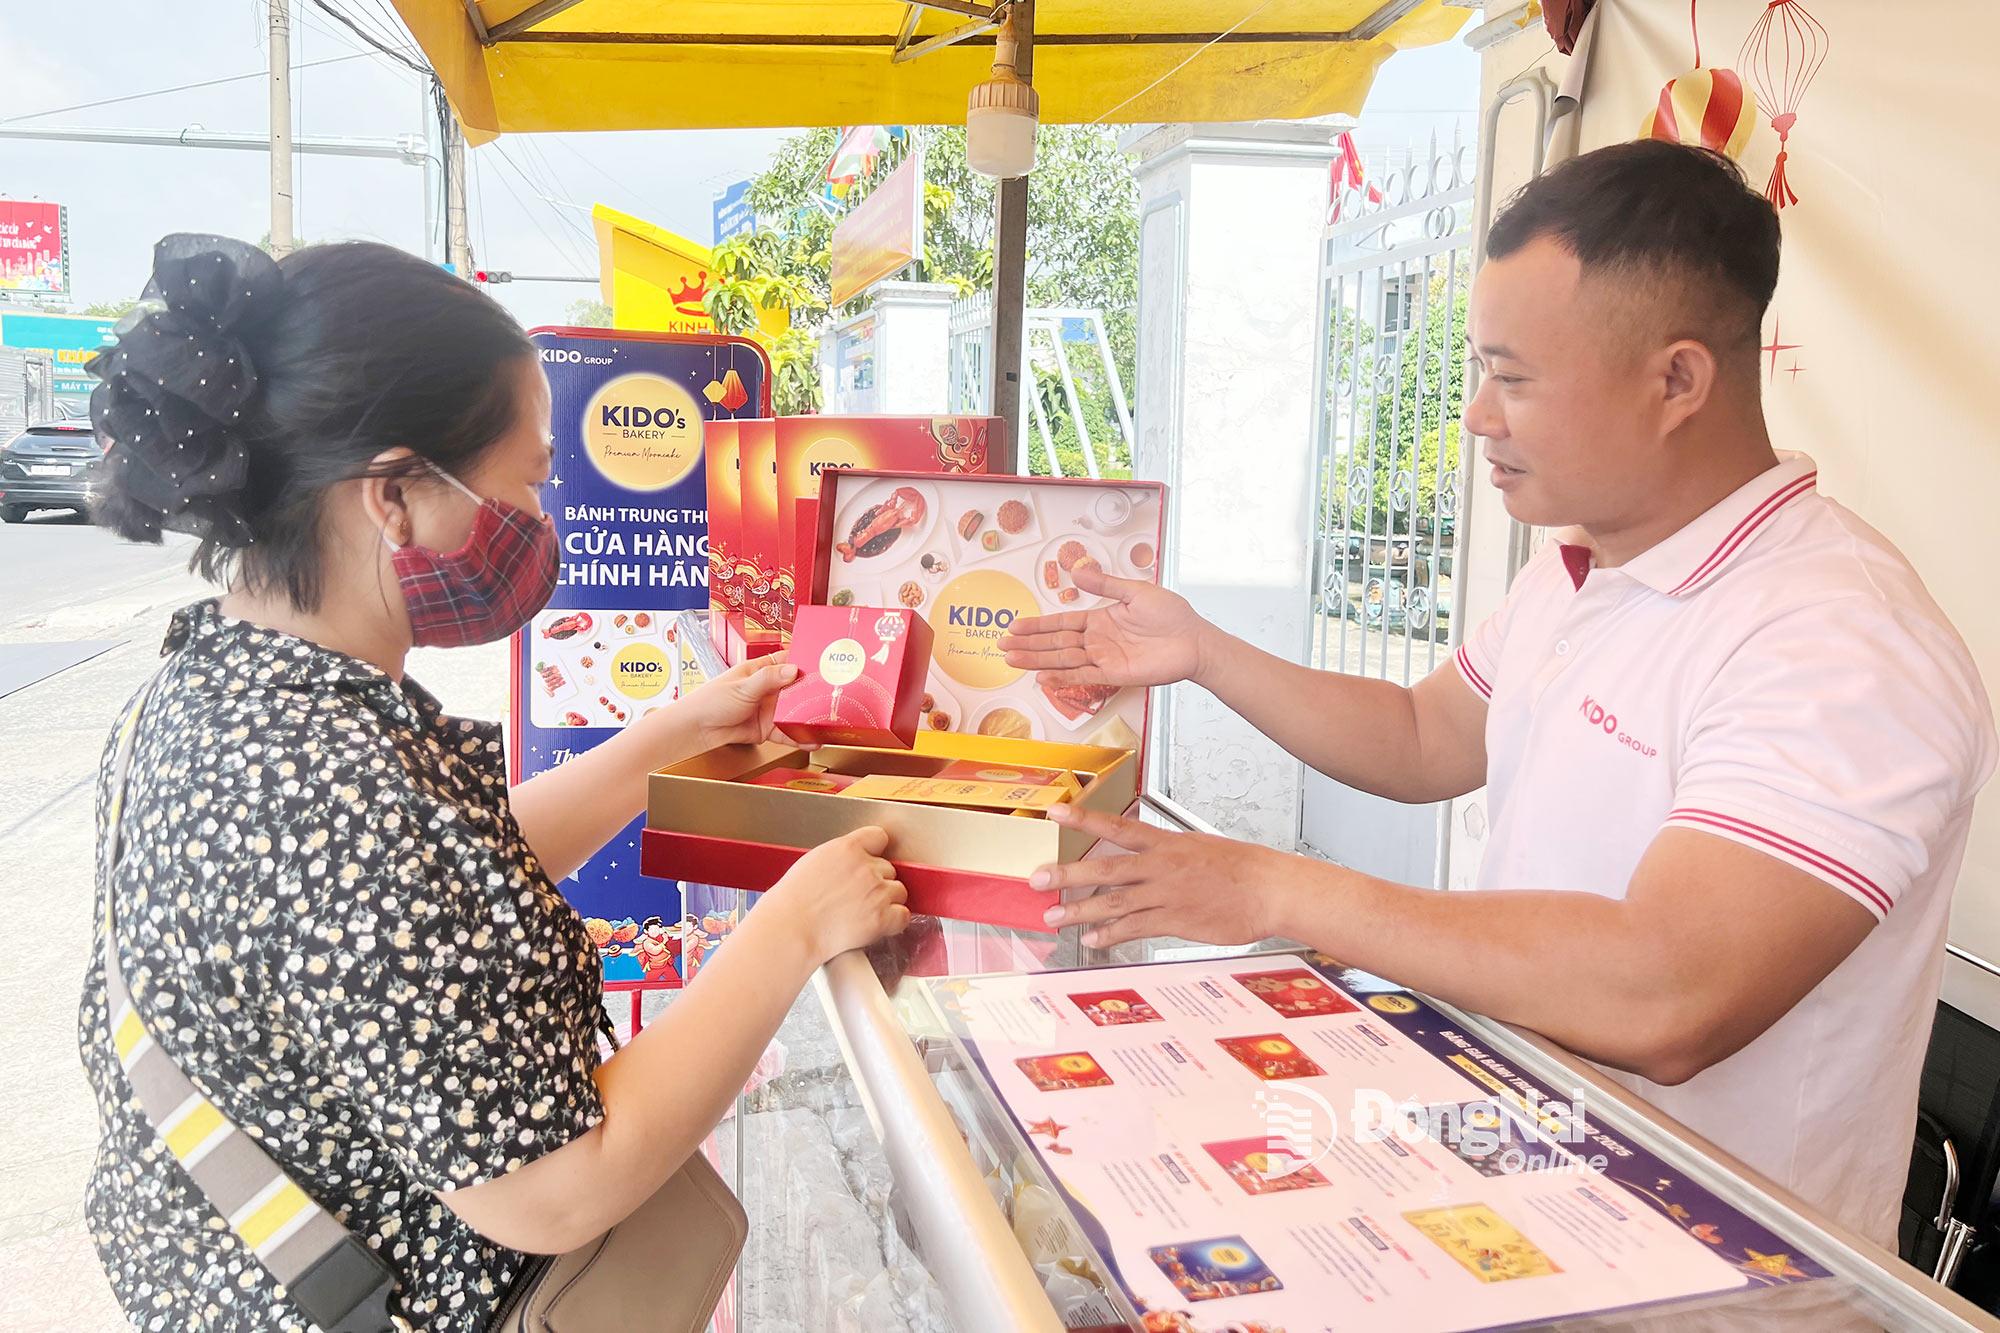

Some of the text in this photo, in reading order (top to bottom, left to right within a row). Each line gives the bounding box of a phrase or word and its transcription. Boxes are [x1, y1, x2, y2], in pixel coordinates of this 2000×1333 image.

[669, 321, 708, 334] KINH
[538, 349, 613, 365] KIDO GROUP
[61, 381, 80, 390] MÁY
[602, 405, 686, 429] KIDO's
[622, 429, 665, 439] BAKERY
[564, 503, 708, 524] BÁNH TRUNG TH
[565, 525, 626, 555] CỬA
[649, 560, 709, 587] HÃN
[948, 605, 1019, 629] KIDO'
[965, 628, 1005, 640] BAKERY
[620, 661, 663, 673] KIDO's
[1617, 732, 1657, 758] GROUP
